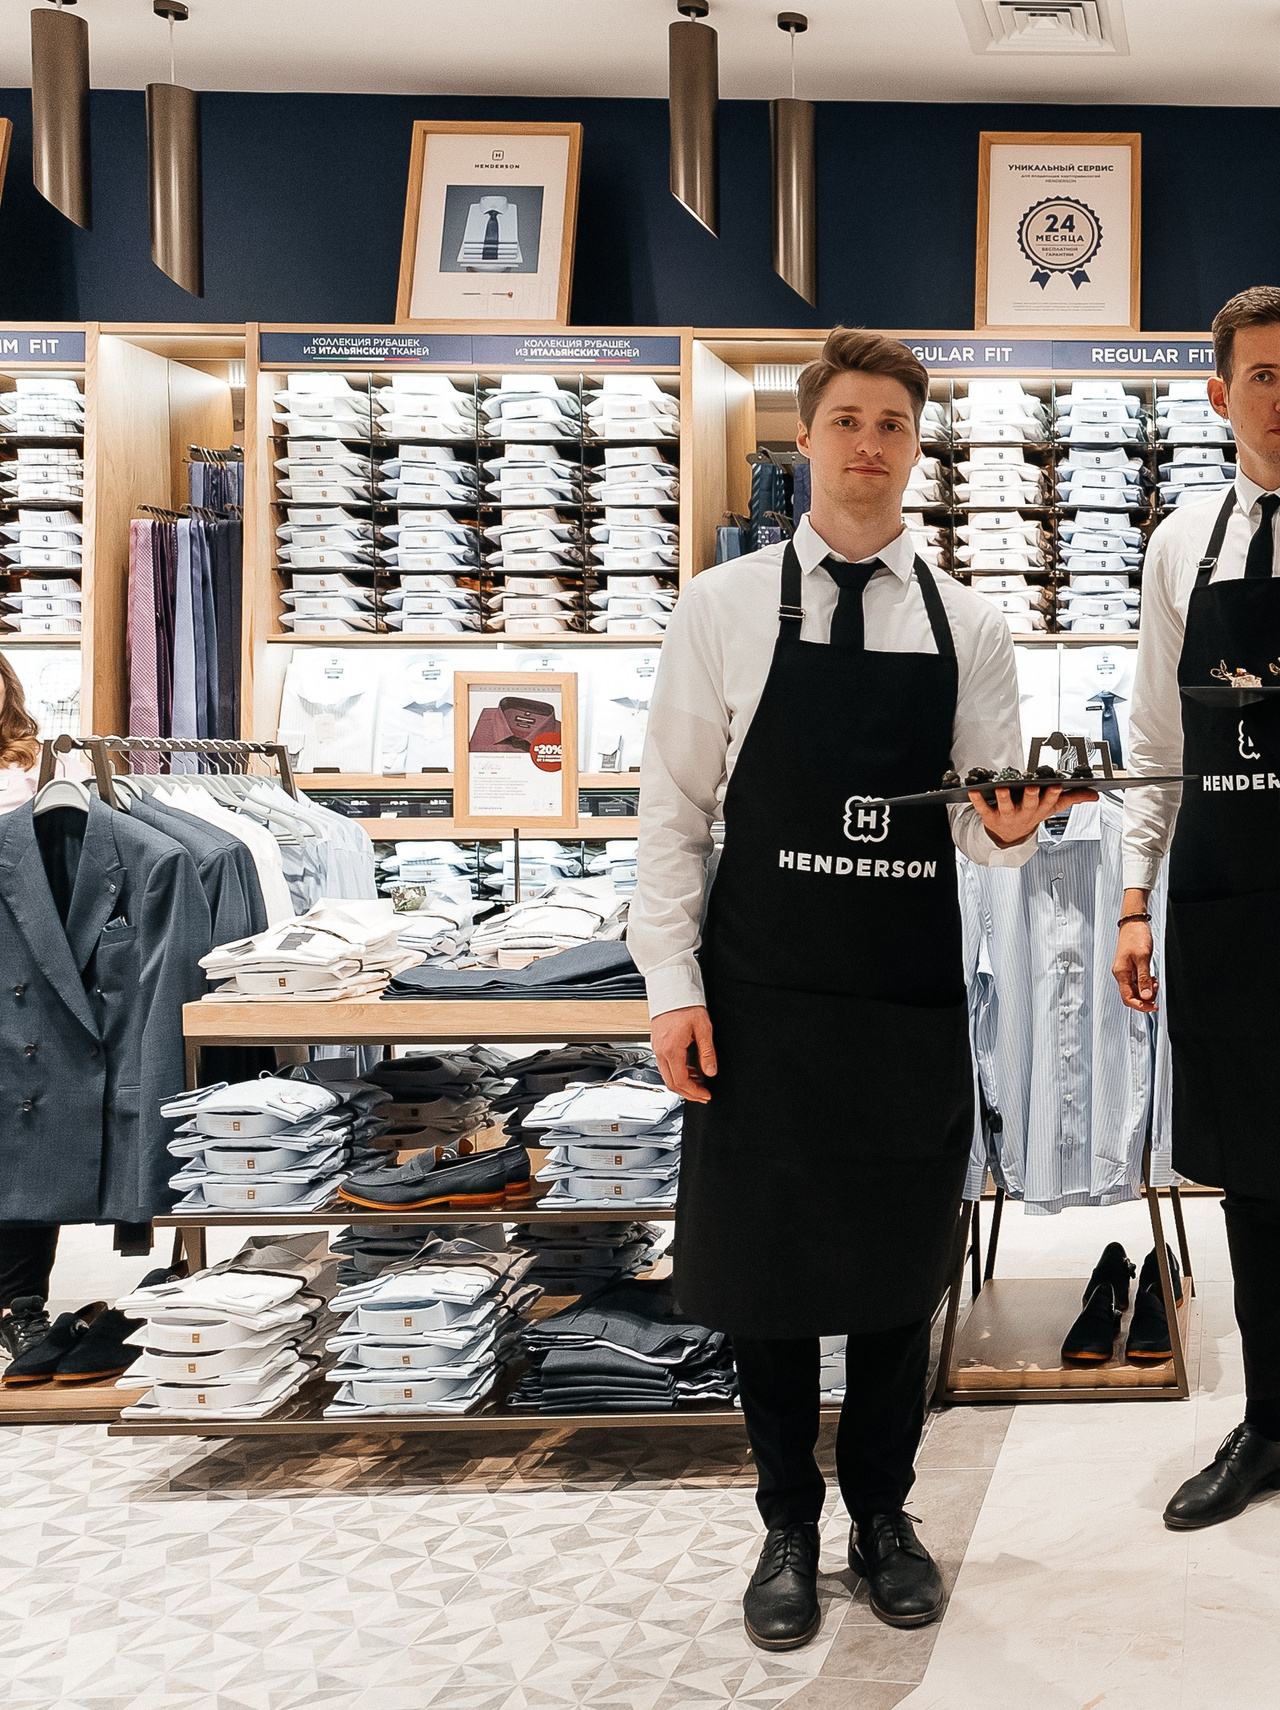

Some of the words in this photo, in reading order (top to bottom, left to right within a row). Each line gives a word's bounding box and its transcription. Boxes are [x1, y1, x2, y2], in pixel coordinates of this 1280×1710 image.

[1008, 163, 1075, 172] УНИКАЛЬНЫЙ
[1045, 214, 1076, 232] 24
[1036, 234, 1084, 243] МЕСЯЦА
[29, 339, 59, 354] FIT
[312, 338, 371, 347] КОЛЛЕКЦИЯ
[373, 338, 420, 347] РУБАШЕК
[524, 339, 583, 348] КОЛЛЕКЦИЯ
[584, 340, 631, 348] РУБАШЕК
[303, 346, 316, 354] ИЗ
[319, 347, 389, 355] ИТАЛЬЯНСКИХ
[391, 346, 430, 356] ТКАНЕЙ
[515, 348, 528, 356] ИЗ
[530, 348, 600, 356] ИТАЛЬЯНСКИХ
[602, 347, 640, 357] ТКАНЕЙ
[911, 346, 975, 362] GULAR
[984, 347, 1013, 362] FIT
[1091, 348, 1179, 363] REGULAR
[1188, 348, 1215, 363] FIT
[857, 809, 877, 829] H
[778, 849, 937, 879] HENDERSON
